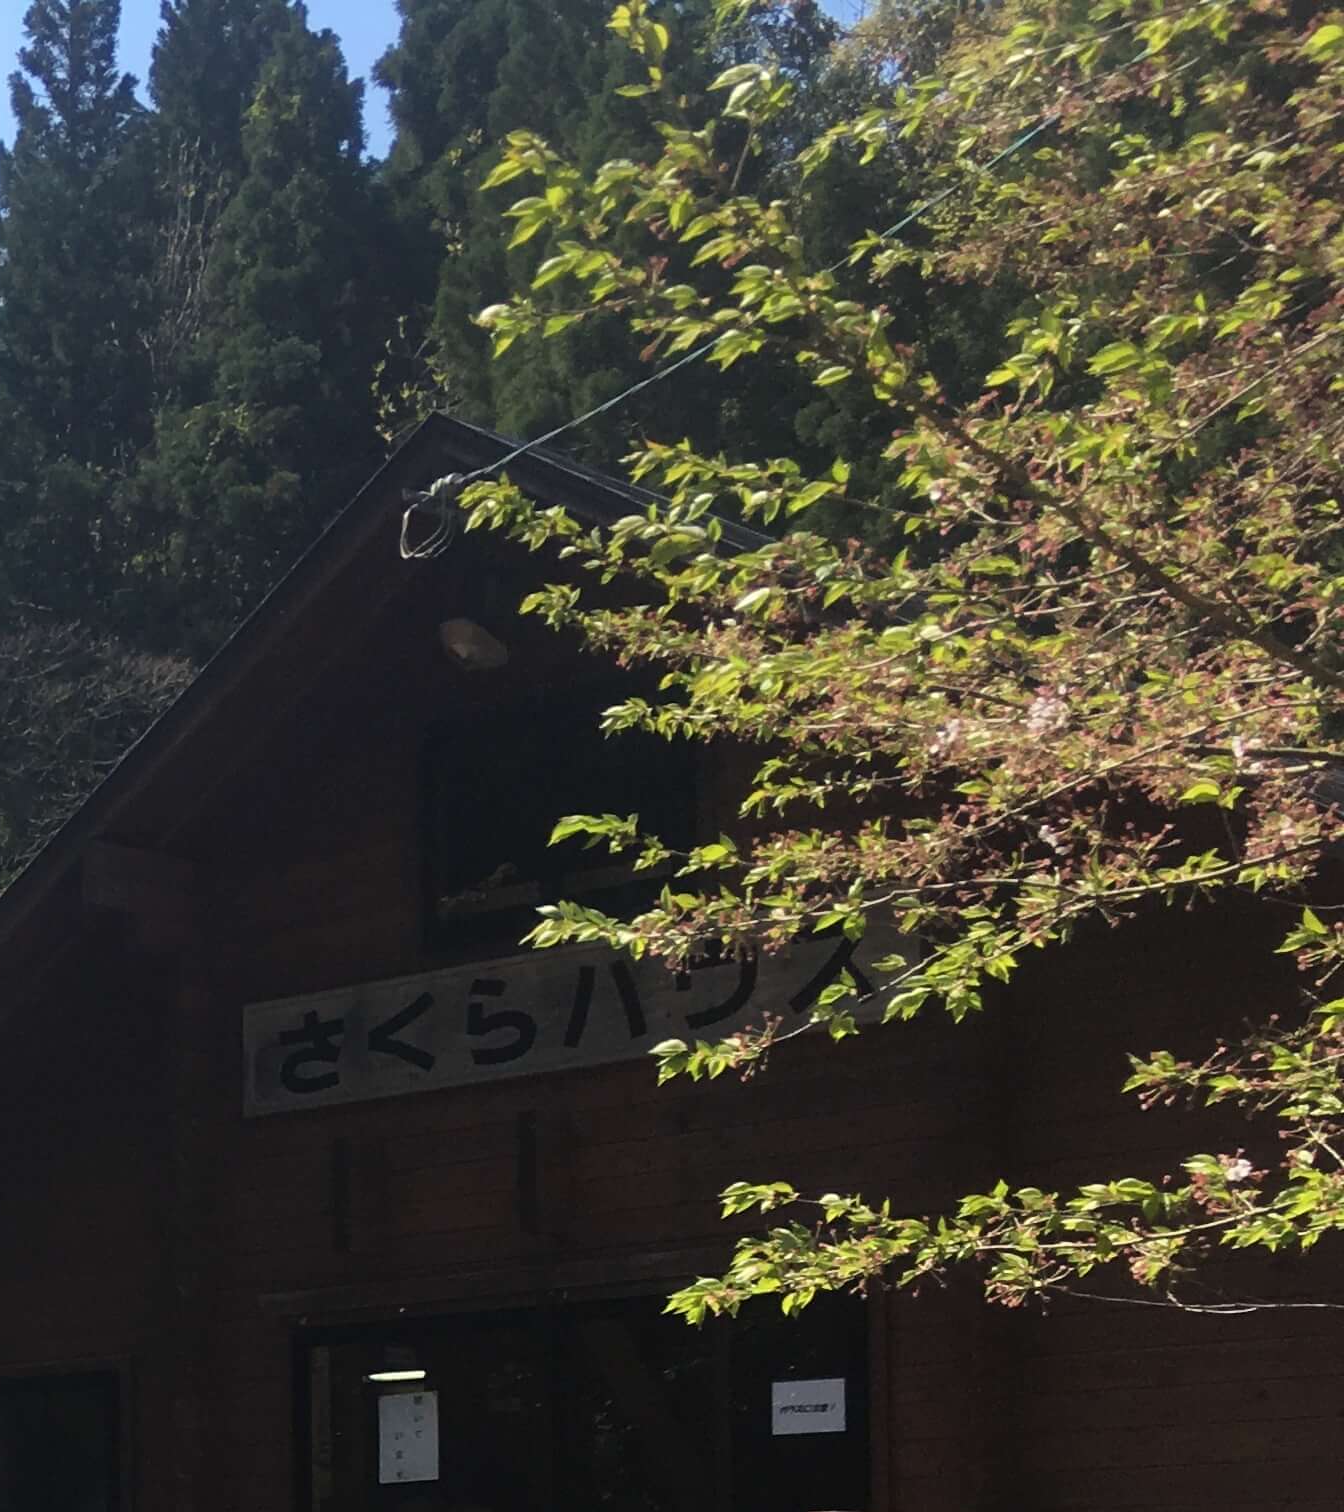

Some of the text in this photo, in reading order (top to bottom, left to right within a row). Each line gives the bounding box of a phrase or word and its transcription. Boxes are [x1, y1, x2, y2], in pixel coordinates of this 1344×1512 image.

[278, 924, 875, 1095] さくらハウス
